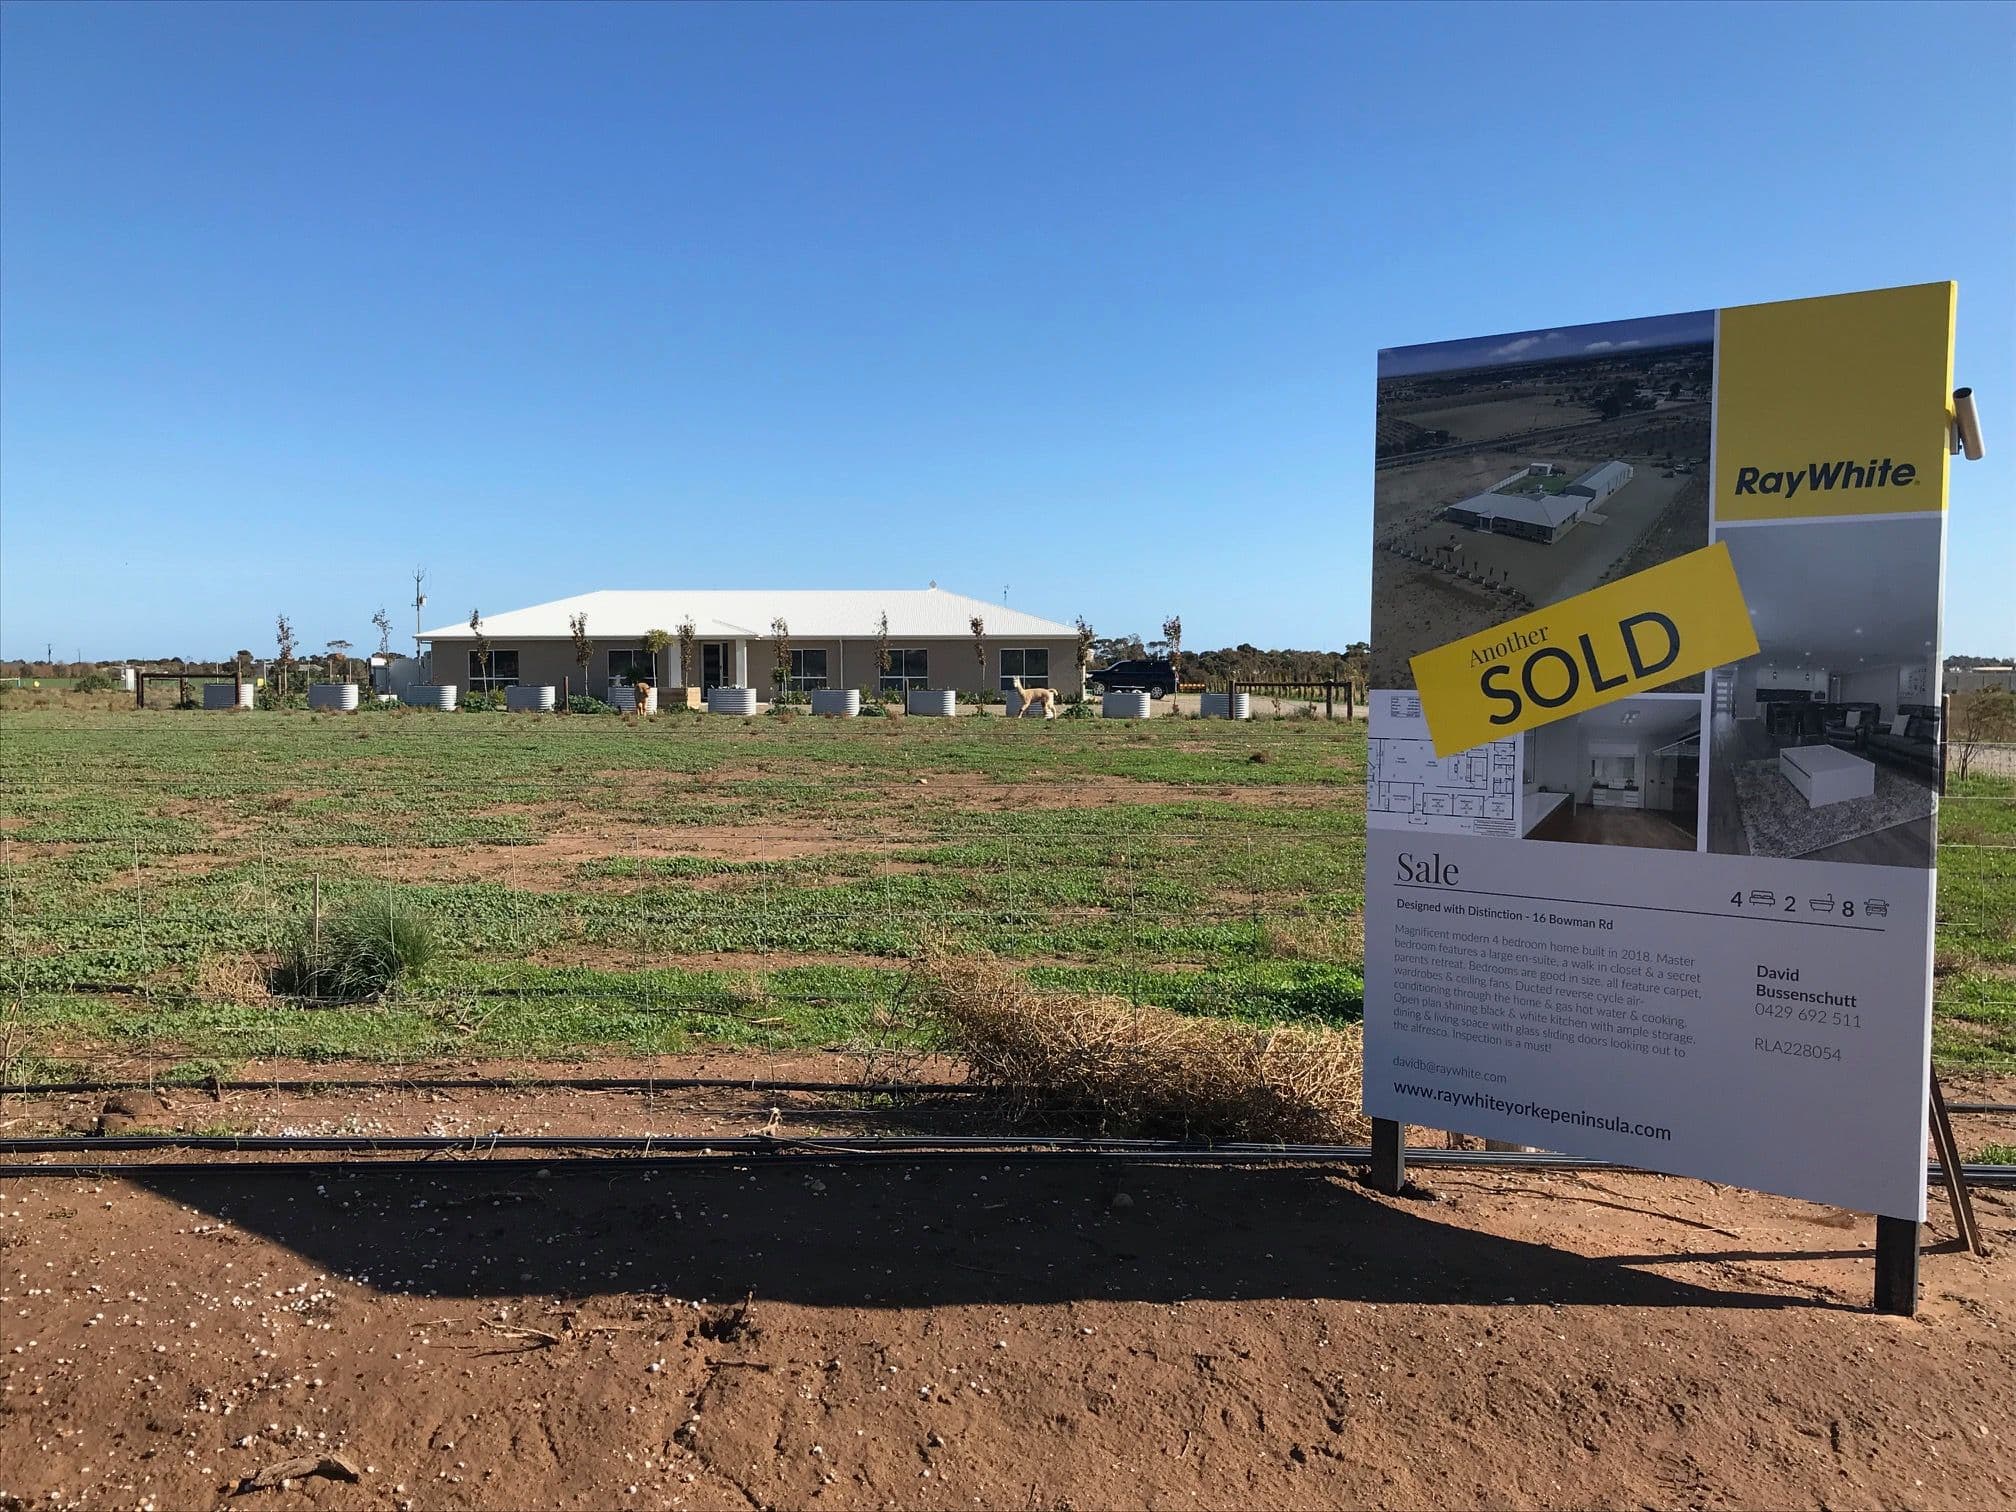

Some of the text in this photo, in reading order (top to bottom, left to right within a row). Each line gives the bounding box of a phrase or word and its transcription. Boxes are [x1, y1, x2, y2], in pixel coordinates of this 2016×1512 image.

[1735, 458, 1916, 499] RayWhite
[1469, 623, 1550, 669] Another
[1480, 612, 1681, 725] SOLD
[1397, 852, 1459, 886] Sale
[1396, 898, 1441, 913] Designed
[1444, 904, 1465, 915] with
[1468, 906, 1522, 920] Distinction
[1532, 913, 1546, 923] 16
[1549, 914, 1596, 928] Bowman
[1599, 919, 1614, 930] Rd
[1730, 892, 1854, 917] 4 2 8
[1394, 938, 1436, 952] bedroom
[1439, 943, 1478, 956] features
[1489, 949, 1513, 962] large
[1562, 960, 1568, 968] a
[1572, 958, 1594, 970] walk
[1598, 962, 1608, 972] in
[1610, 964, 1642, 976] closet
[1645, 967, 1654, 978] &
[1658, 970, 1664, 978] a
[1667, 970, 1702, 984] secret
[1395, 924, 1449, 940] Magnificent
[1452, 932, 1490, 944] modern
[1492, 936, 1499, 944] 4
[1502, 936, 1546, 950] bedroom
[1550, 942, 1579, 952] home
[1582, 945, 1605, 958] built
[1608, 949, 1618, 959] in
[1656, 954, 1696, 966] Master
[1393, 967, 1442, 980] wardrobes
[1446, 972, 1453, 982] &
[1456, 974, 1486, 988] ceiling
[1516, 981, 1552, 995] Ducted
[1556, 988, 1594, 1000] reverse
[1597, 992, 1624, 1005] cycle
[1626, 996, 1645, 1006] air-
[1394, 954, 1428, 966] parents
[1469, 961, 1518, 976] Bedrooms
[1521, 968, 1538, 978] are
[1540, 968, 1566, 983] good
[1569, 974, 1578, 984] in
[1606, 978, 1618, 989] all
[1622, 979, 1660, 993] feature
[1756, 965, 1800, 982] David
[1394, 980, 1450, 998] conditioning
[1454, 988, 1492, 1002] through
[1494, 992, 1510, 1004] the
[1513, 997, 1542, 1008] home
[1544, 1000, 1553, 1010] &
[1556, 1002, 1573, 1013] gas
[1576, 1003, 1593, 1016] hot
[1596, 1008, 1627, 1020] water
[1630, 1010, 1638, 1020] &
[1394, 992, 1420, 1006] Open
[1422, 996, 1442, 1010] plan
[1444, 1000, 1478, 1016] shining
[1481, 1004, 1505, 1017] black
[1508, 1008, 1516, 1018] &
[1519, 1011, 1548, 1023] white
[1550, 1013, 1588, 1029] kitchen
[1590, 1020, 1614, 1032] with
[1617, 1026, 1648, 1038] ample
[1754, 1002, 1862, 1028] 0429 692 511
[1756, 984, 1856, 1008] Bussenschutt
[1394, 1007, 1686, 1058] dining & living space with glass sliding doors looking out to
[1394, 1021, 1408, 1032] the
[1452, 1030, 1502, 1046] Inspection
[1505, 1038, 1512, 1047] is
[1515, 1040, 1521, 1048] a
[1754, 1037, 1842, 1062] RLA228054
[1392, 1056, 1507, 1084] davidb@raywhite.com
[1394, 1082, 1671, 1141] www.raywhiteyorkepeninsula.com
